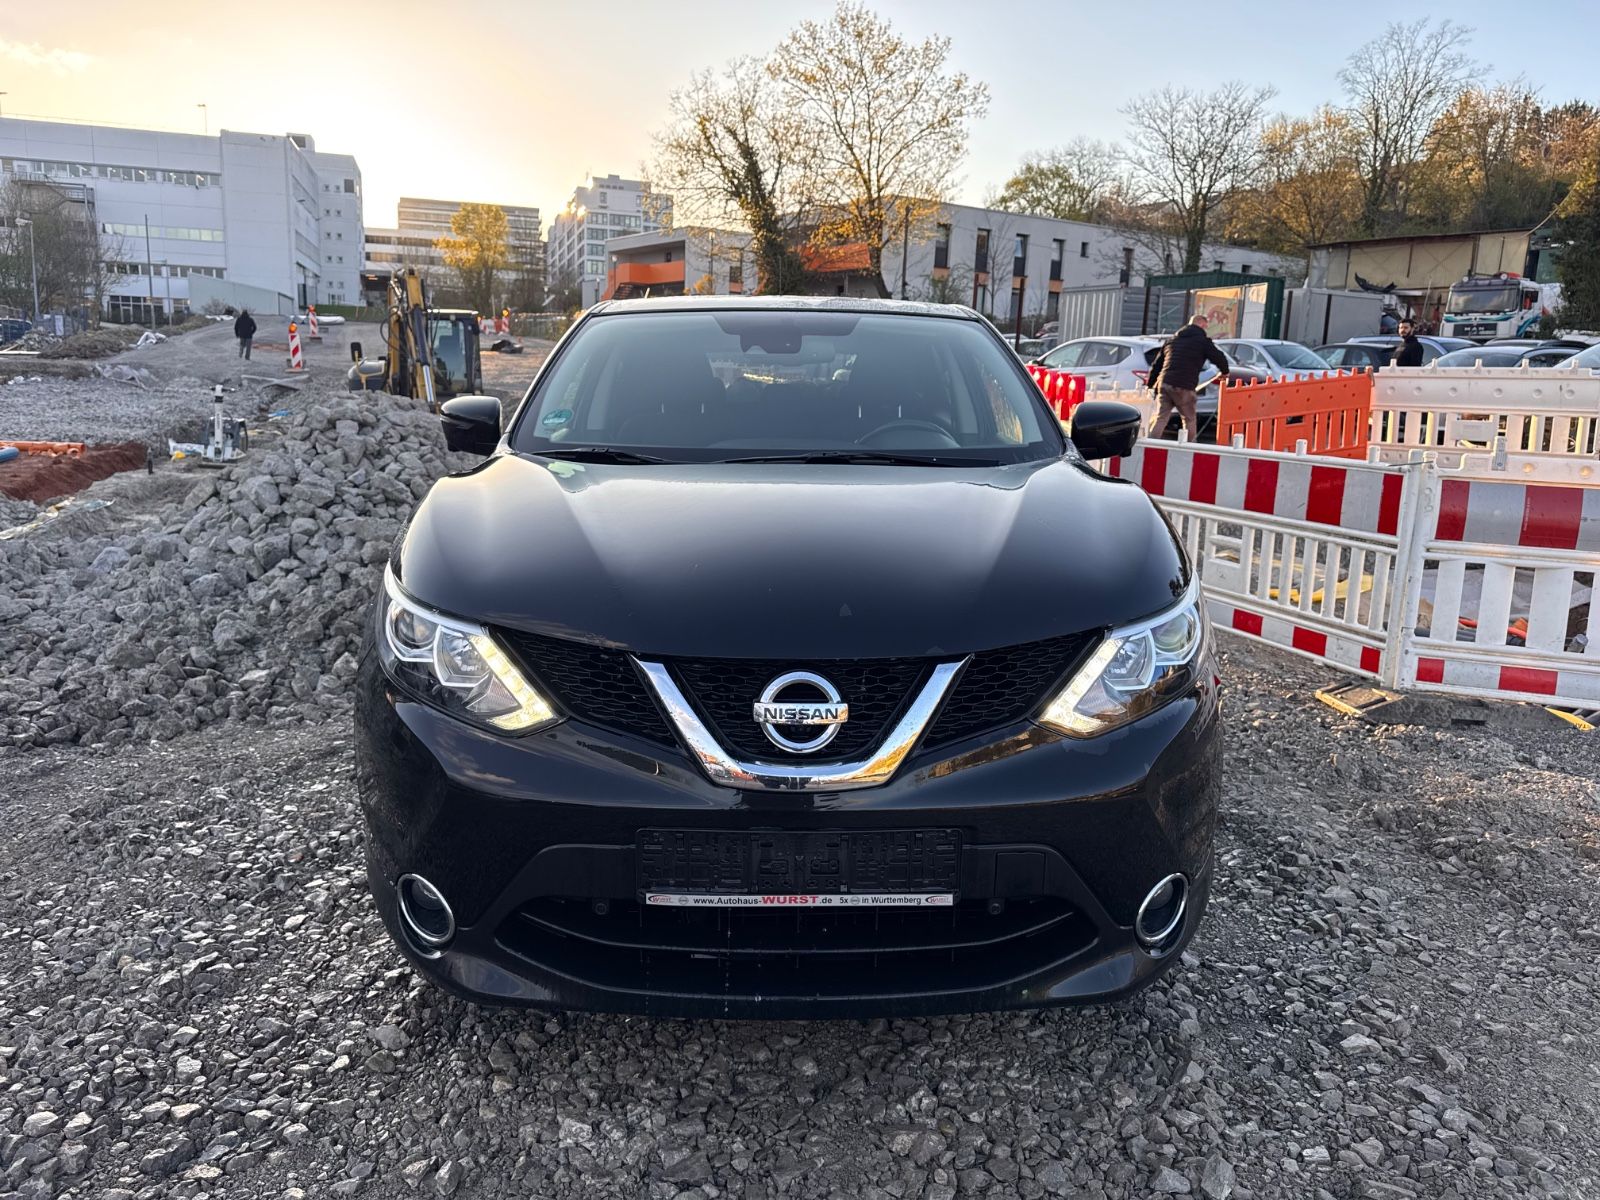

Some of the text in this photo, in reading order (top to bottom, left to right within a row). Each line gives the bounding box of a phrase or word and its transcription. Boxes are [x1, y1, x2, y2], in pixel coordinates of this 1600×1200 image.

[764, 707, 839, 720] NISSAN
[693, 896, 922, 905] www.Autohaus-WURST.de 5x in Württemberg
